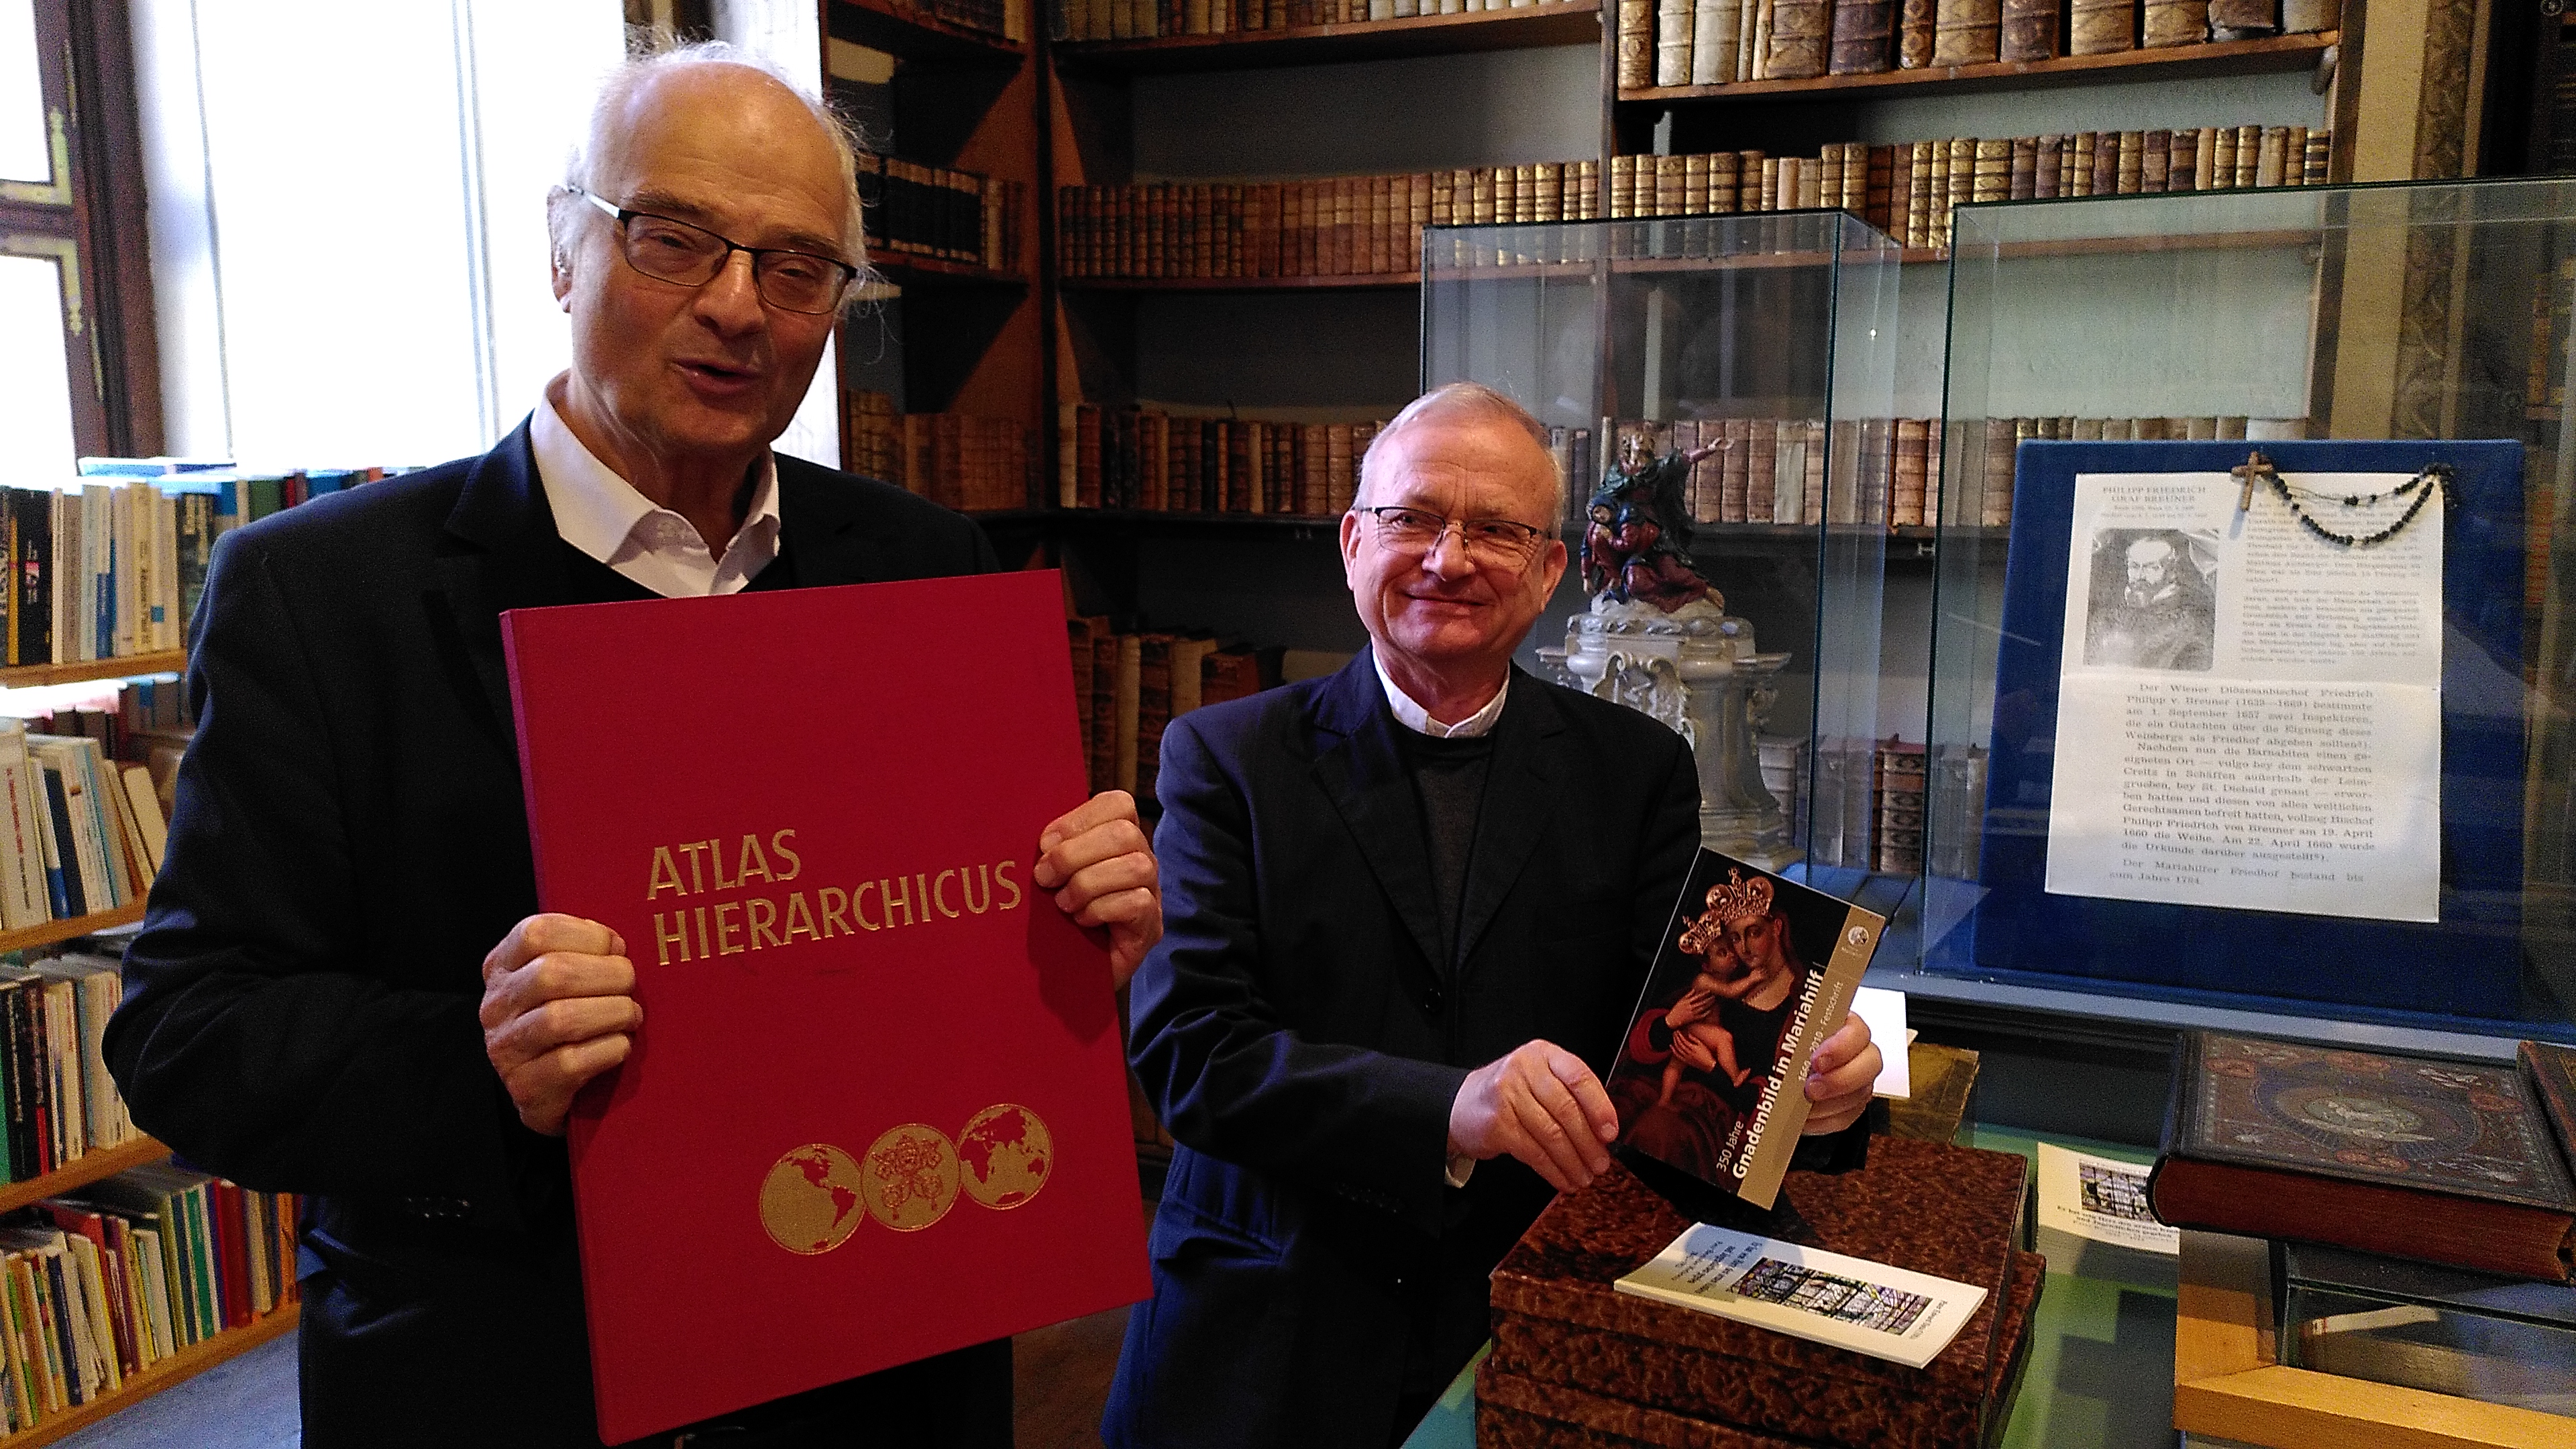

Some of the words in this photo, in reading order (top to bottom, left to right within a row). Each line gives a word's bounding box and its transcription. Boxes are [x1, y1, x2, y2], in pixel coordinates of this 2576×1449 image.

[647, 828, 802, 900] ATLAS
[653, 860, 1022, 966] HIERARCHICUS
[1781, 968, 1824, 1054] Mariahilf
[1820, 981, 1844, 1026] Festschrift
[1772, 1055, 1791, 1076] in
[1716, 1148, 1733, 1173] 350
[1725, 1120, 1744, 1150] Jahre
[1732, 1075, 1782, 1179] Gnadenbild
